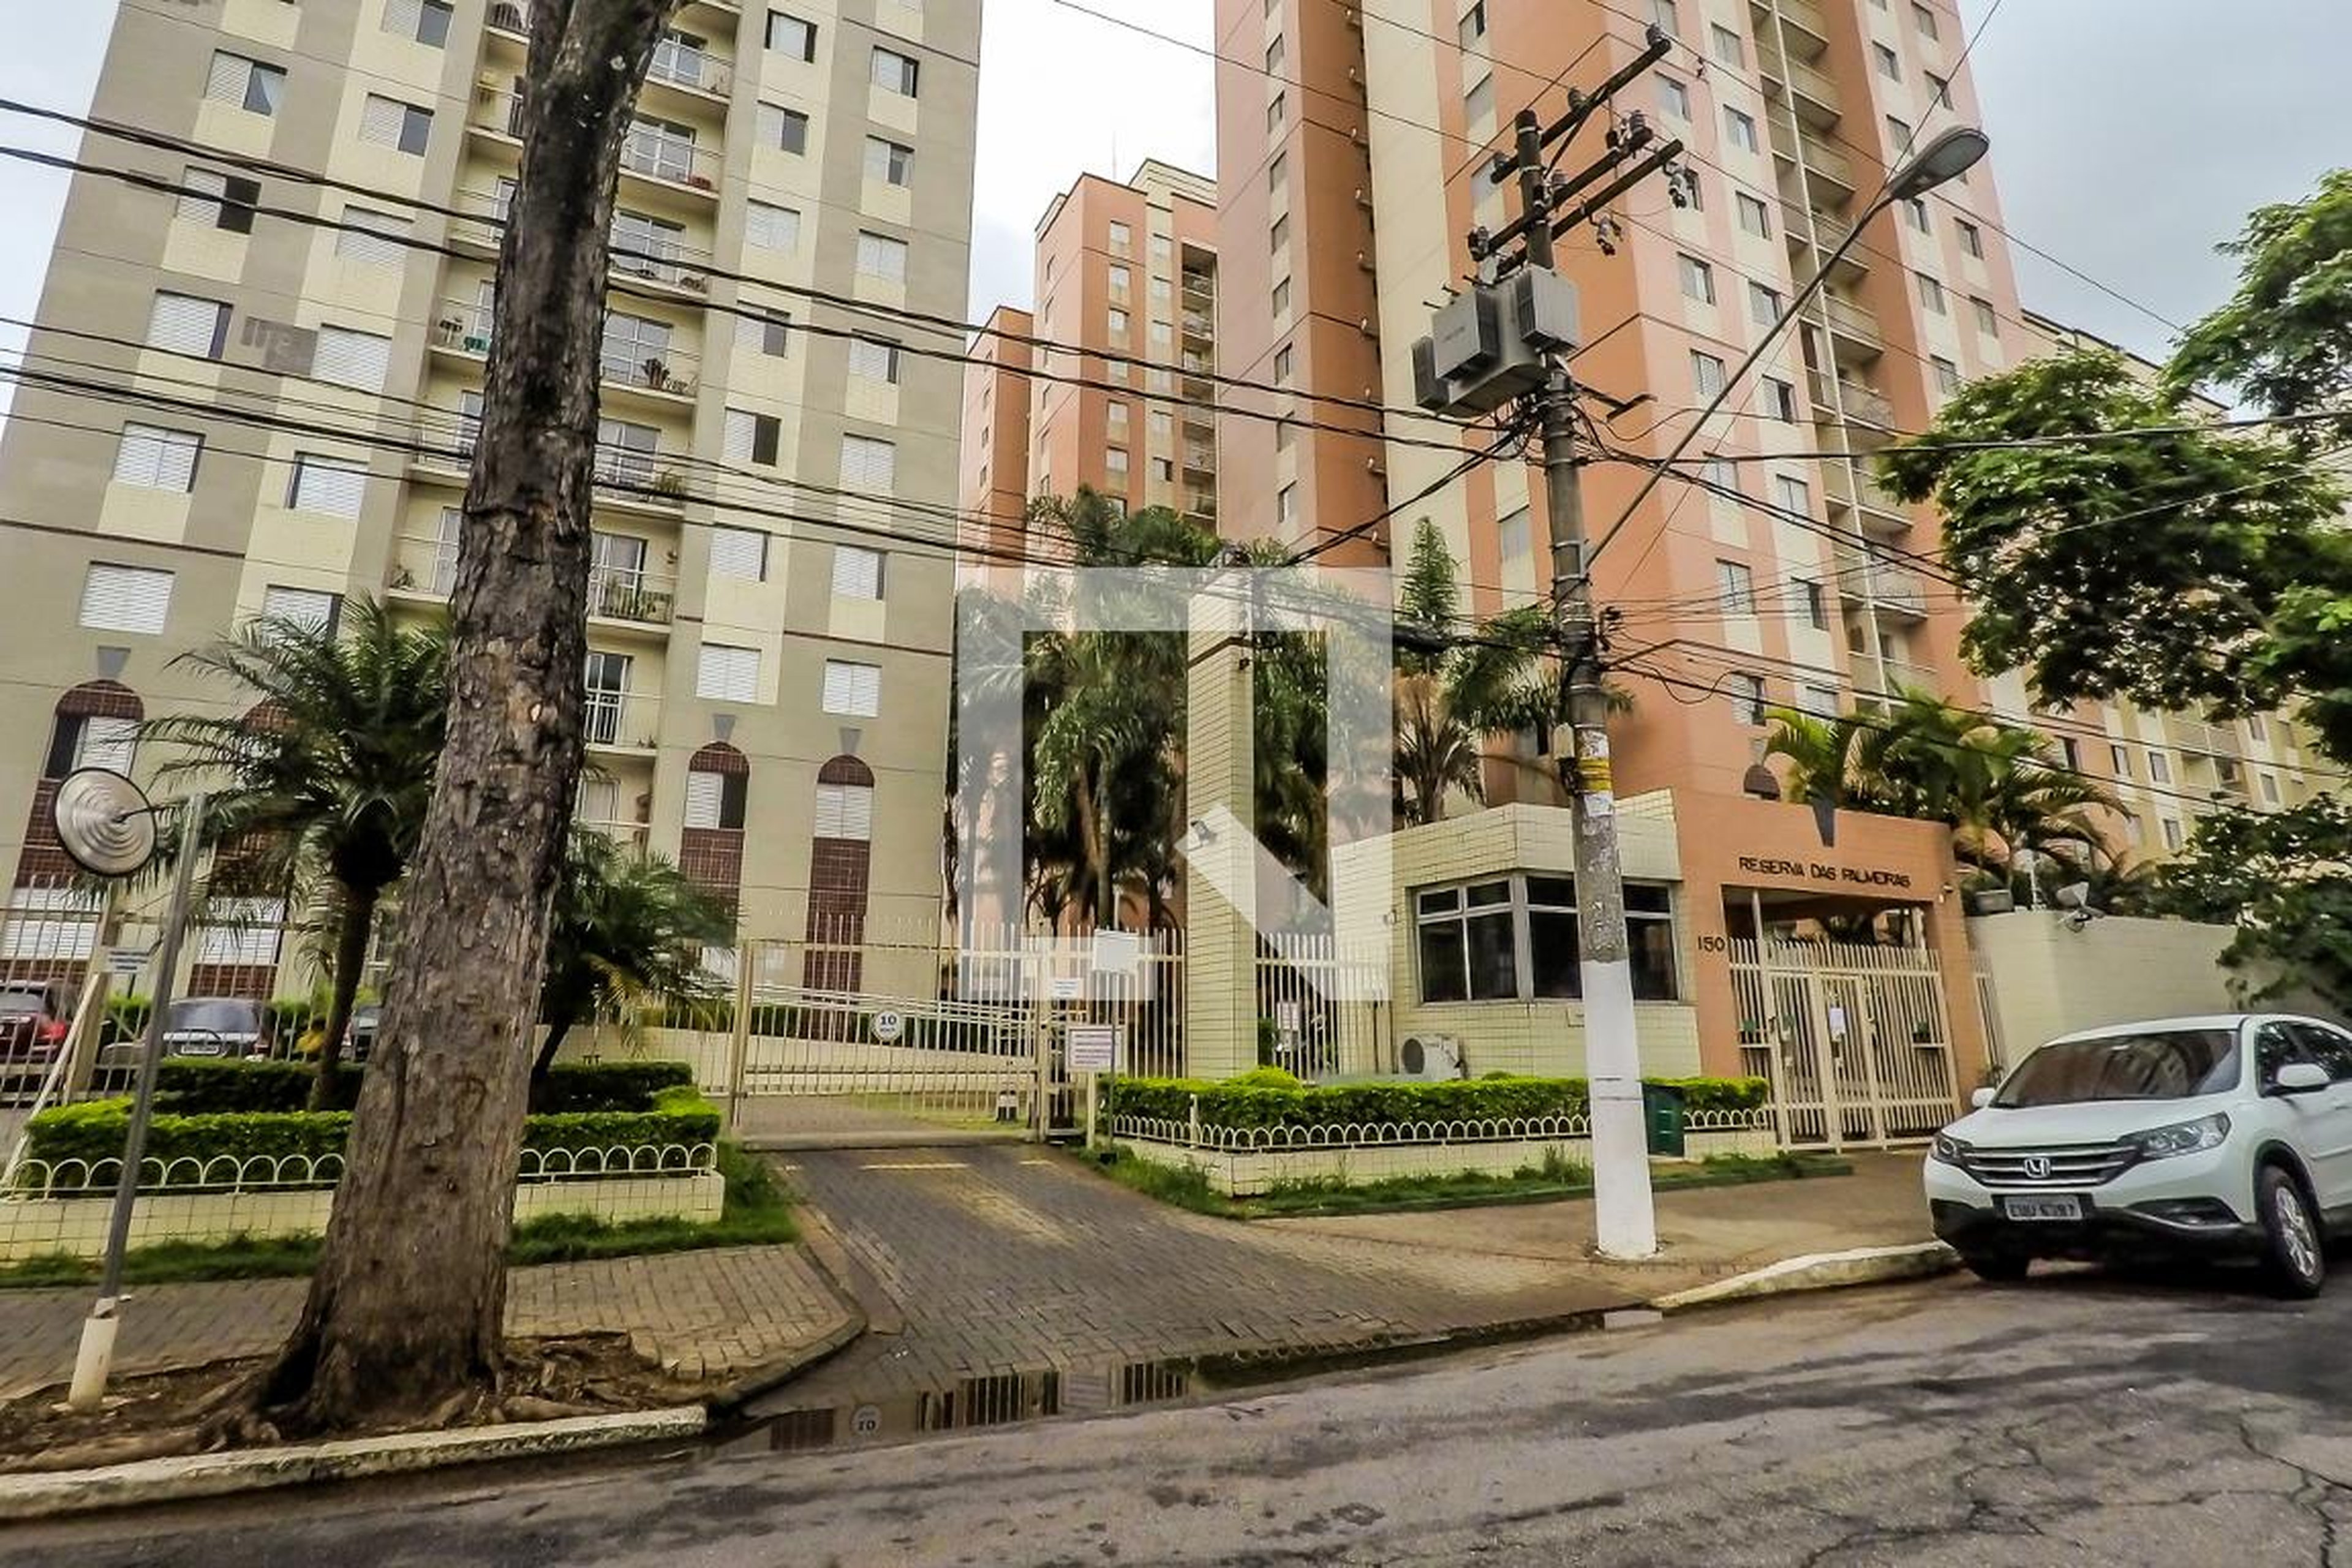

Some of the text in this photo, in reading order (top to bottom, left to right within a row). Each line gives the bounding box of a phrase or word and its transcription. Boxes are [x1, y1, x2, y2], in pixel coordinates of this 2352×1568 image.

[1738, 856, 1911, 888] RESERVA DAS PALMEIRAS
[1697, 935, 1725, 952] 150
[881, 1014, 897, 1025] 10
